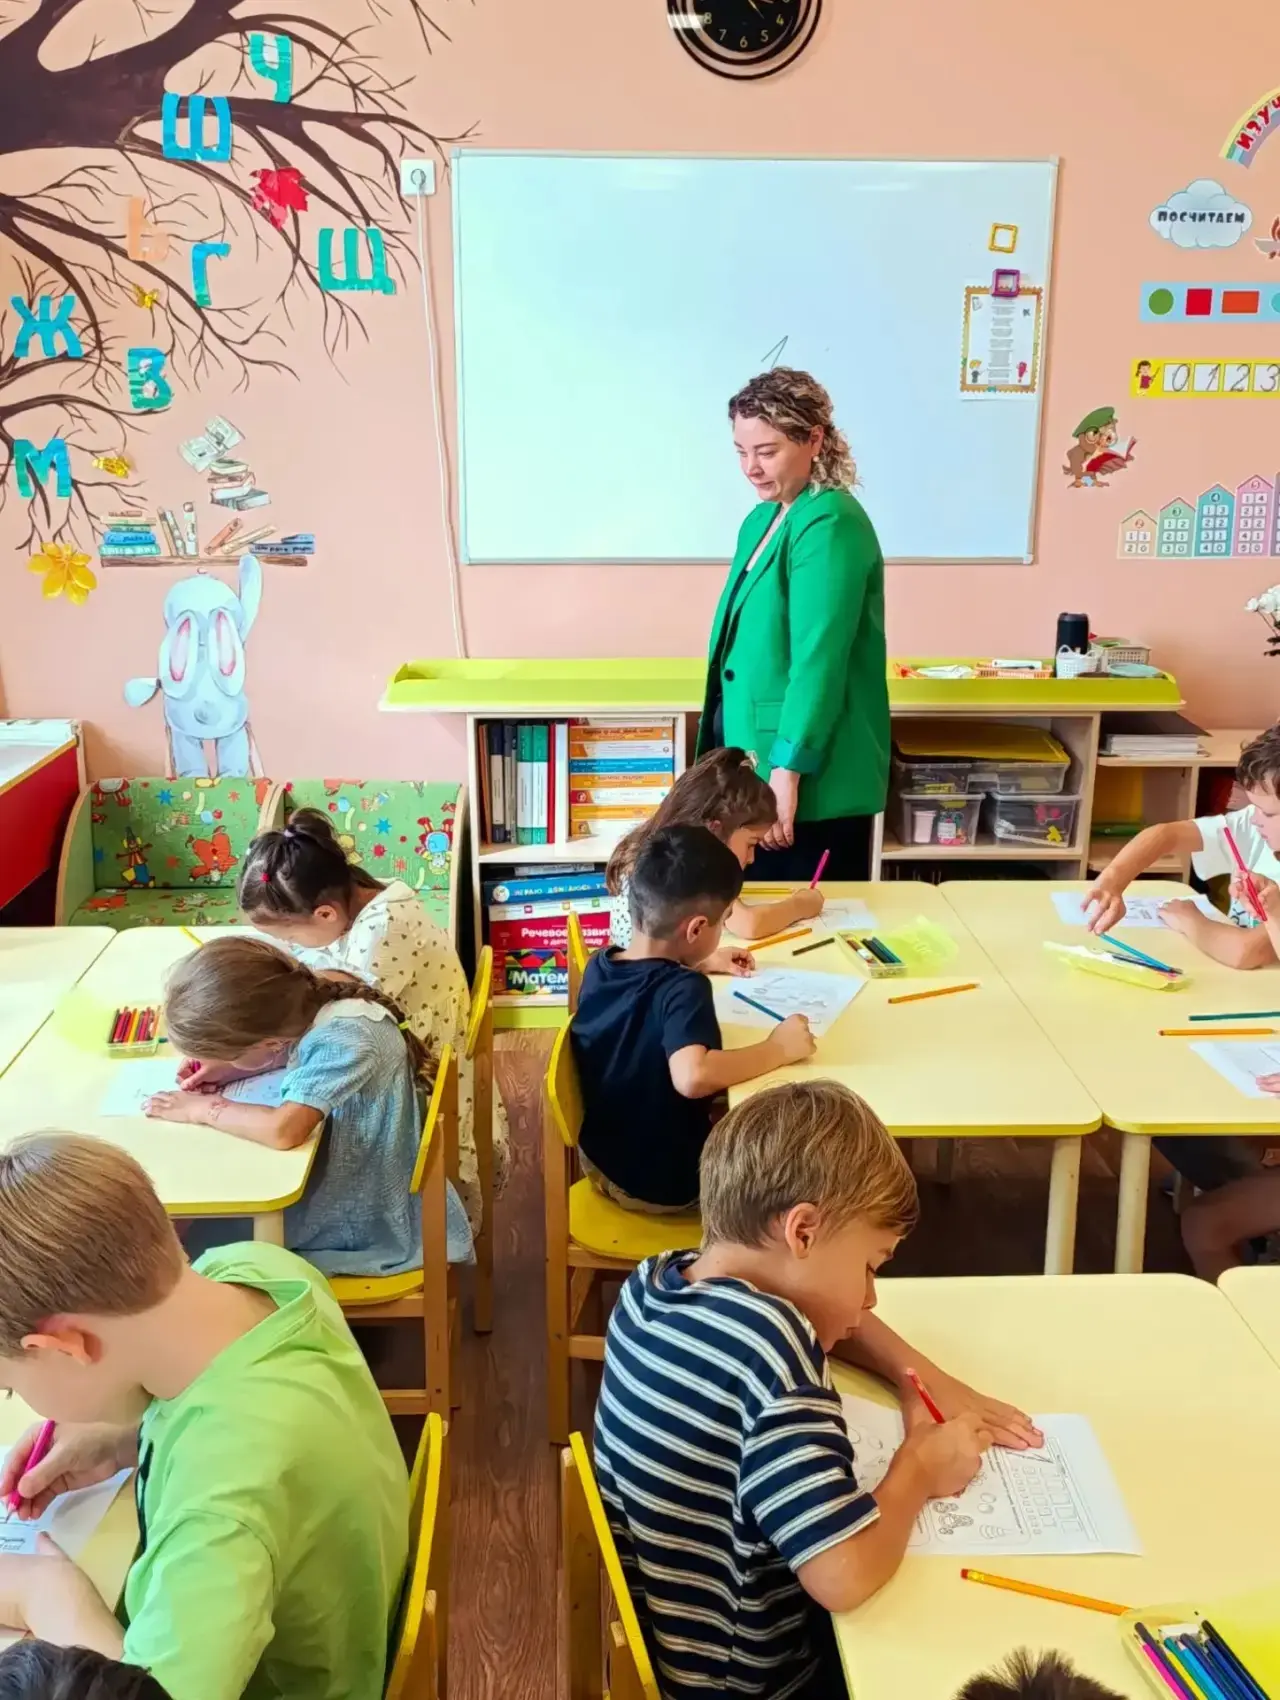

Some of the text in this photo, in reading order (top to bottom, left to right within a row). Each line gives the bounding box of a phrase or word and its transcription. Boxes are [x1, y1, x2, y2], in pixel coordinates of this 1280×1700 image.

[704, 12, 712, 24] 8
[776, 14, 784, 25] 4
[719, 29, 727, 40] 7
[740, 36, 748, 48] 6
[761, 29, 769, 42] 5
[249, 34, 291, 103] Ч
[162, 93, 231, 162] Ш
[1157, 211, 1245, 223] ПОСЧИТАЕМ
[190, 243, 230, 305] Г
[318, 228, 396, 294] Щ
[11, 295, 83, 358] Ж
[127, 347, 173, 409] В
[1172, 363, 1280, 392] 0 1 2 3
[13, 437, 71, 497] М
[512, 970, 568, 985] Матем
